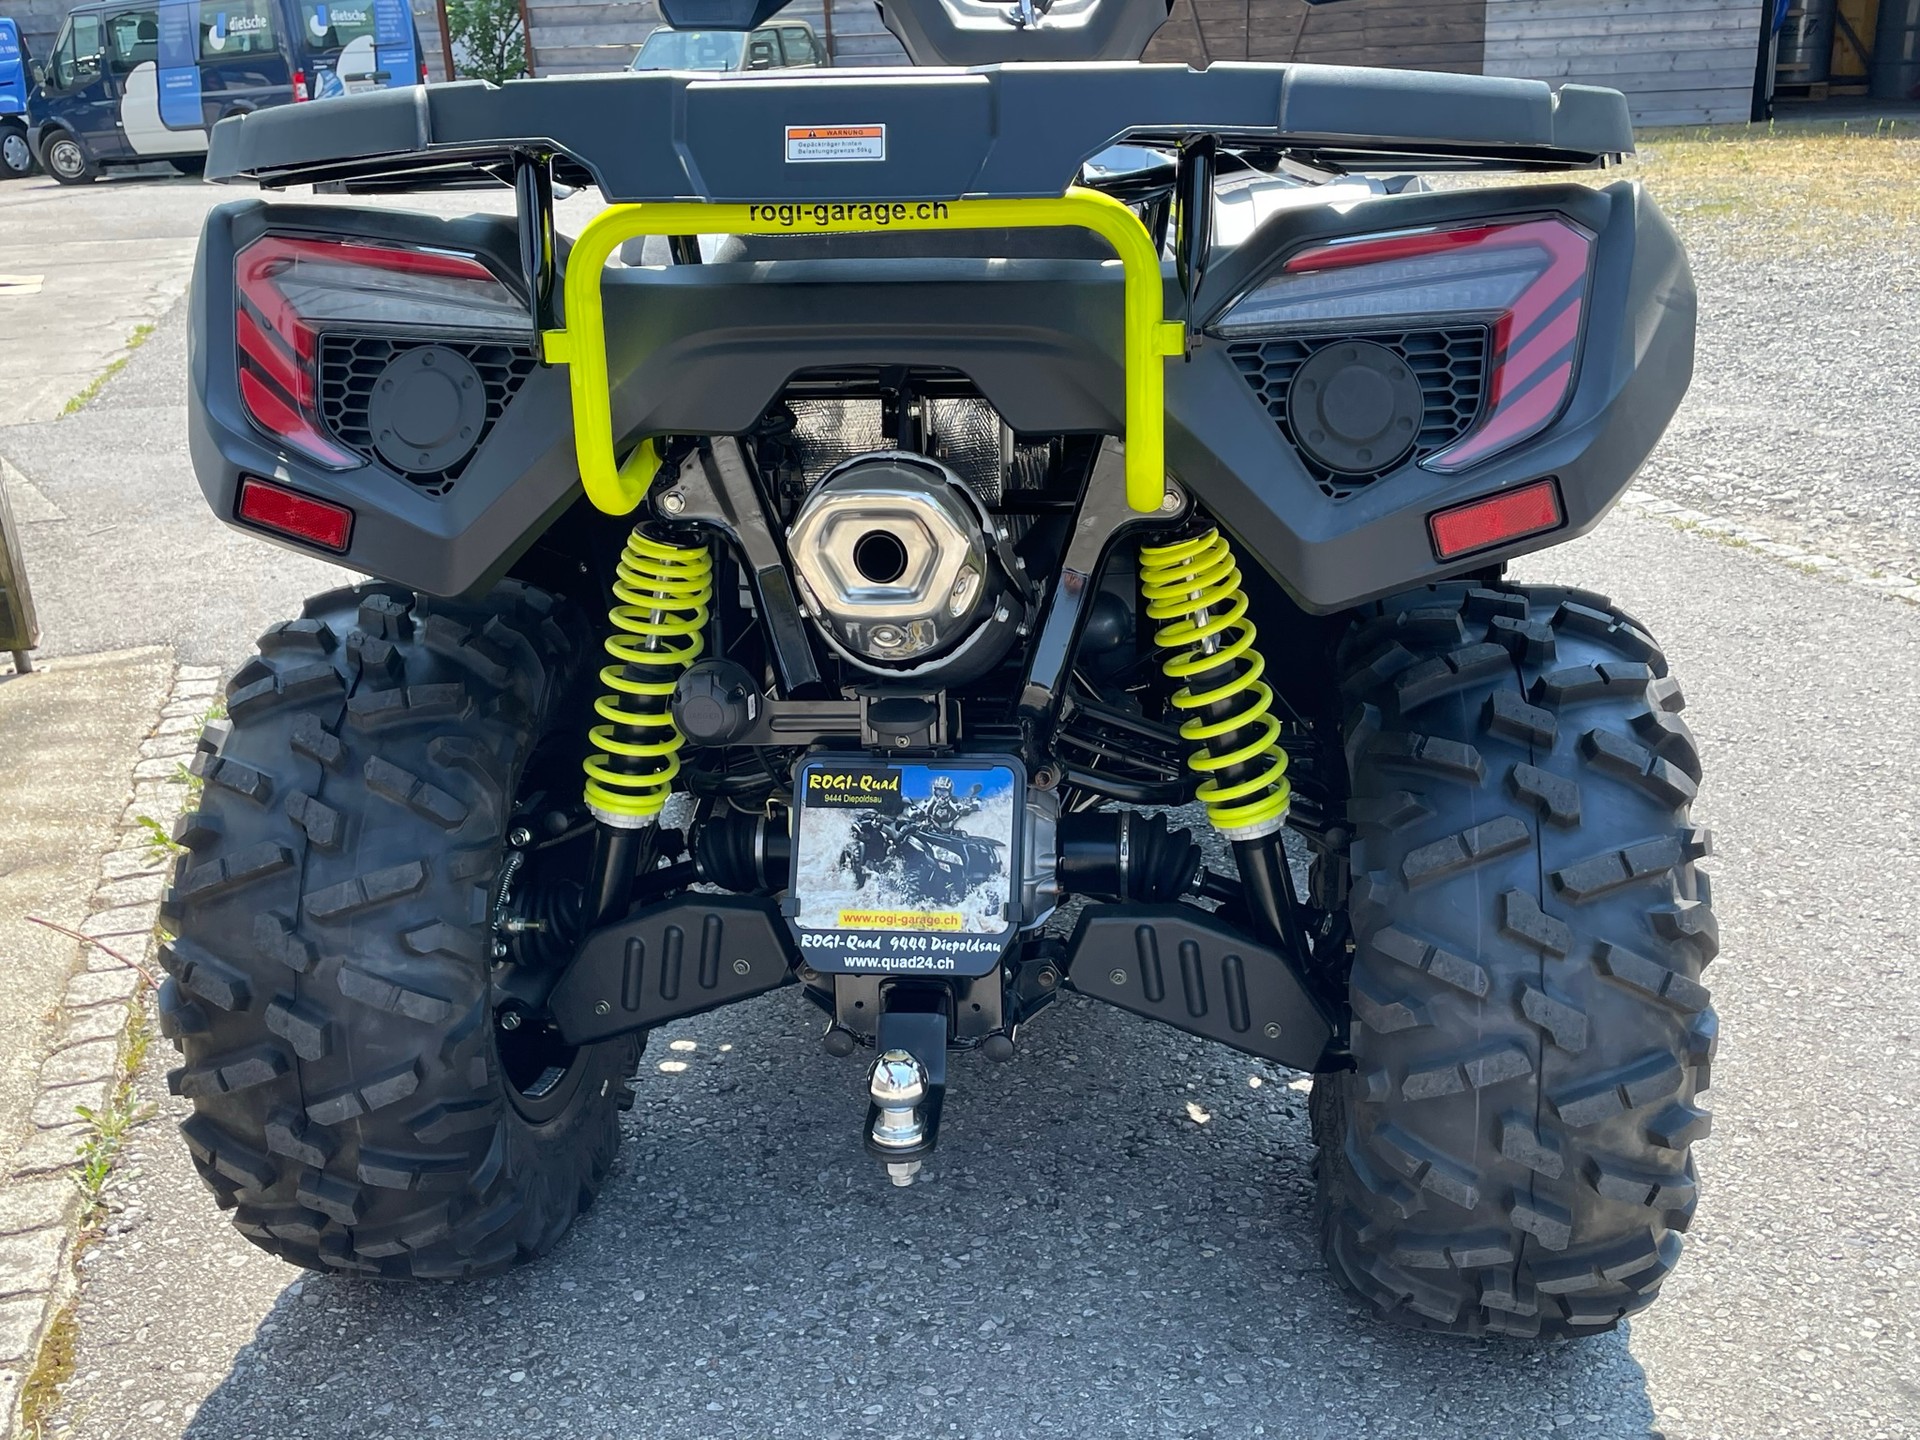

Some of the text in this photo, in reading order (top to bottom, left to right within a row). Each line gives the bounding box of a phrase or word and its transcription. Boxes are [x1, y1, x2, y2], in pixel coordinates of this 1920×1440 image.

[229, 14, 267, 31] dietsche
[330, 9, 367, 21] dietsche
[750, 201, 949, 226] rogi-garage.ch
[809, 774, 899, 792] ROGI-Quad
[824, 794, 882, 804] 9444 Diepoldsau
[843, 912, 958, 927] www.rogi-garage.ch
[801, 934, 1001, 955] ROGI-Quad 9444 Diepoldsau
[844, 955, 954, 970] www.quad24.ch
